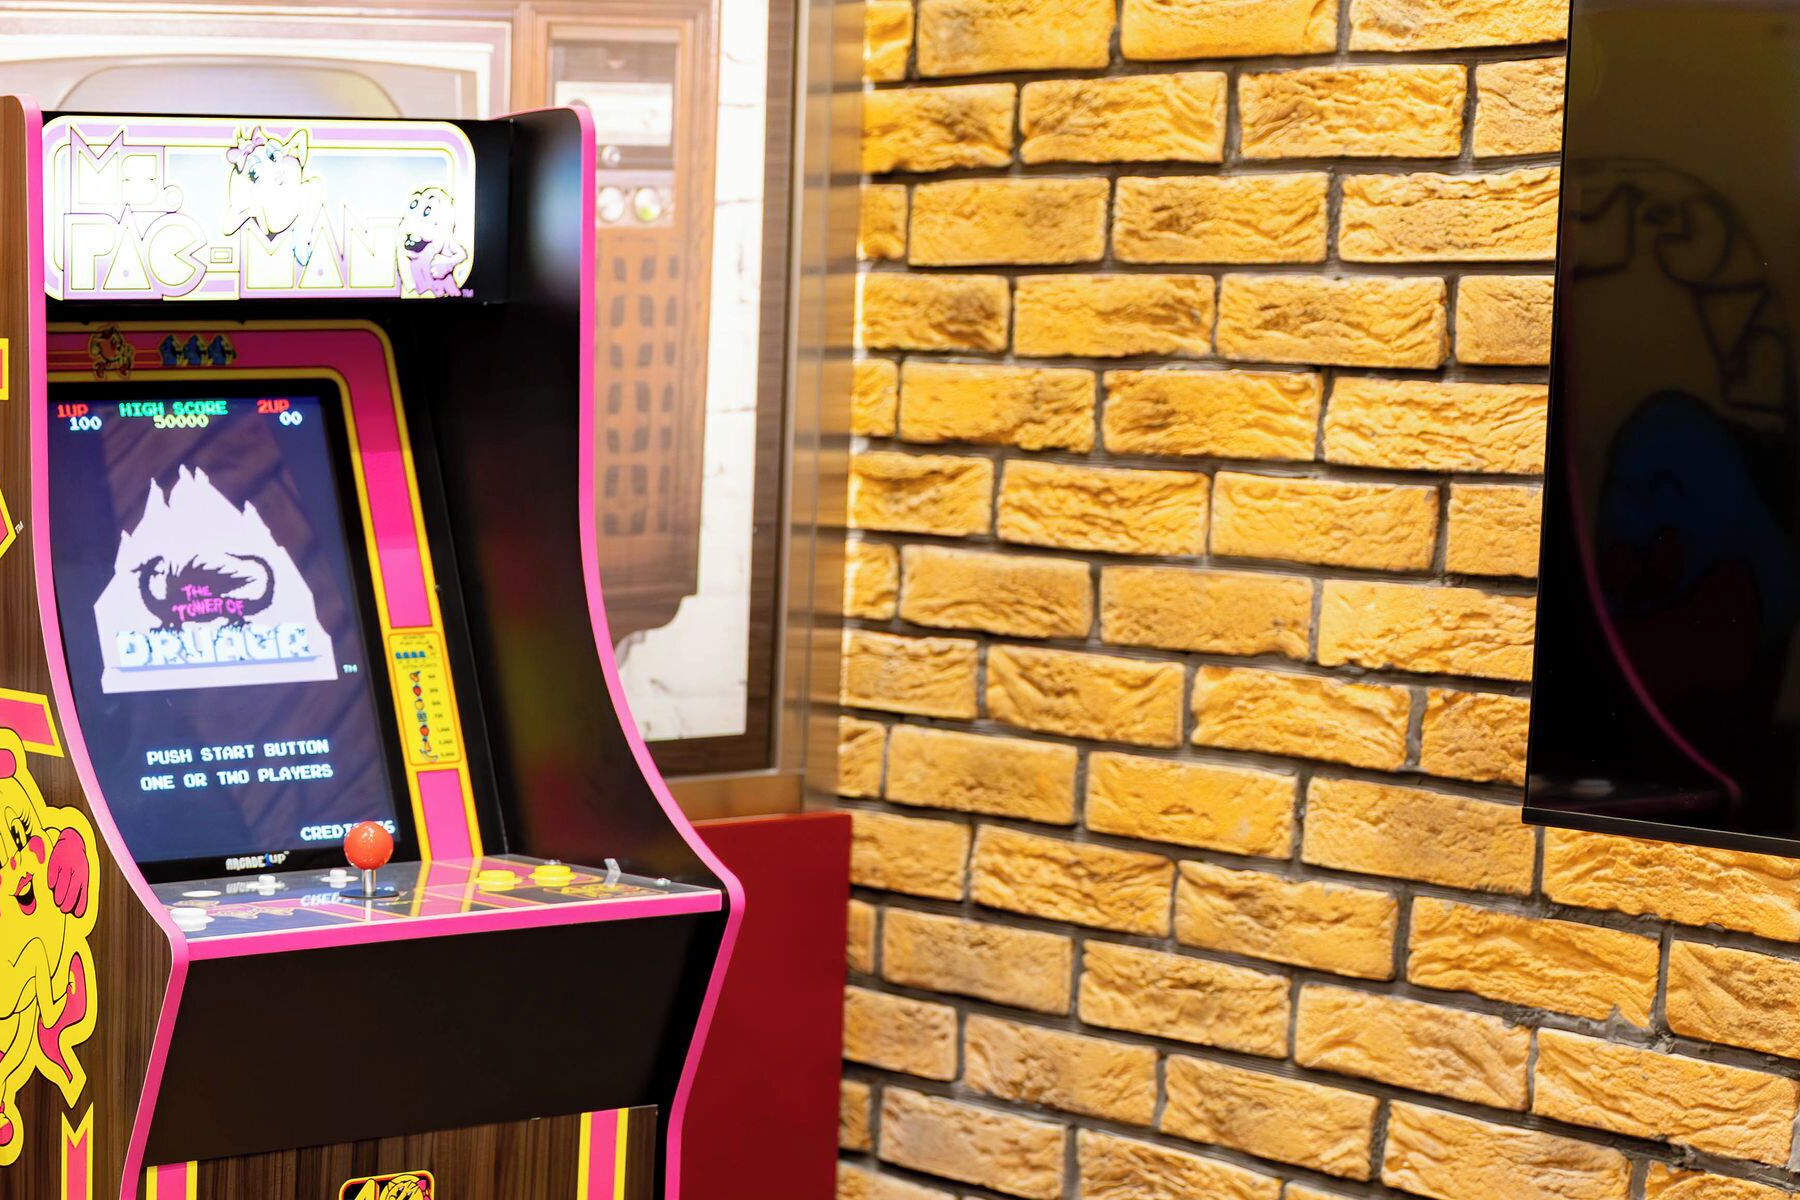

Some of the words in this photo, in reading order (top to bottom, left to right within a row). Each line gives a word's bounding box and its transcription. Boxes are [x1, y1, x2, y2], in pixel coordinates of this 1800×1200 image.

[63, 203, 401, 299] PAC-MAN
[57, 404, 89, 418] 1UP
[118, 402, 166, 417] HIGH
[172, 400, 228, 416] SCORE
[257, 399, 290, 414] 2UP
[69, 416, 102, 431] 100
[153, 413, 209, 429] 50000
[279, 411, 303, 426] 00
[181, 584, 212, 600] THE
[171, 598, 223, 622] TOWER
[225, 599, 245, 617] OF
[146, 748, 193, 766] PUSH
[200, 744, 255, 762] START
[264, 739, 329, 758] BUTTON
[140, 774, 175, 791] ONE
[183, 772, 208, 789] OR
[216, 769, 250, 786] TWO
[257, 763, 334, 783] PLAYERS
